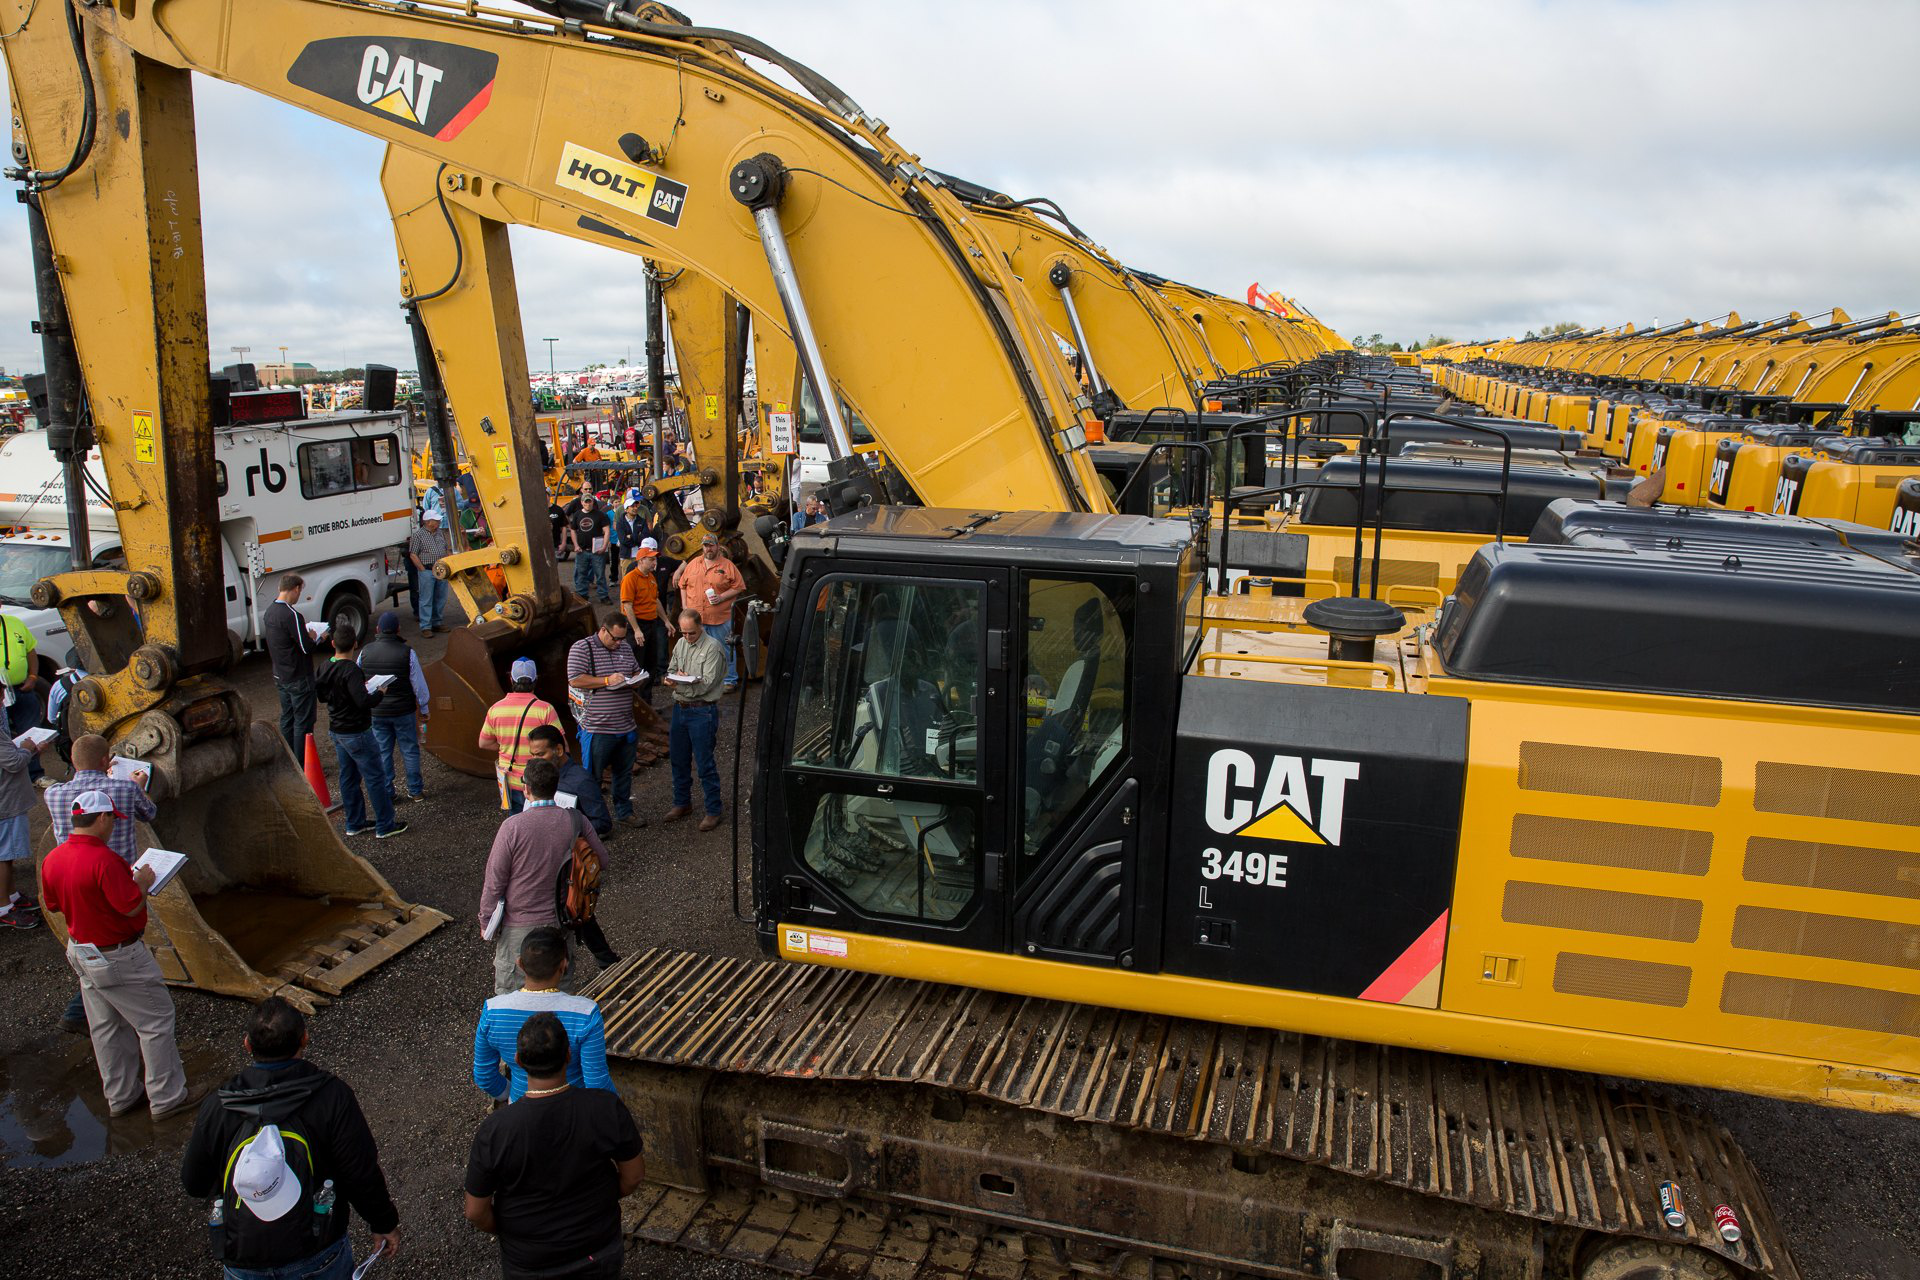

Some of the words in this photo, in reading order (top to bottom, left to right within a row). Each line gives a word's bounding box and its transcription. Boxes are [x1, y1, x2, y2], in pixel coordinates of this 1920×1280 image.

[357, 44, 444, 126] CAT
[567, 158, 646, 198] HOLT
[653, 189, 681, 214] CAT
[774, 434, 790, 443] Being
[776, 444, 788, 452] Sold
[246, 447, 287, 497] rb
[1772, 475, 1799, 516] CAT
[308, 522, 331, 536] RITCHIE
[331, 519, 351, 531] BROS.
[351, 515, 383, 528] Auctioneers
[1205, 748, 1360, 846] CAT
[1201, 847, 1288, 888] 349E
[1199, 885, 1213, 909] L
